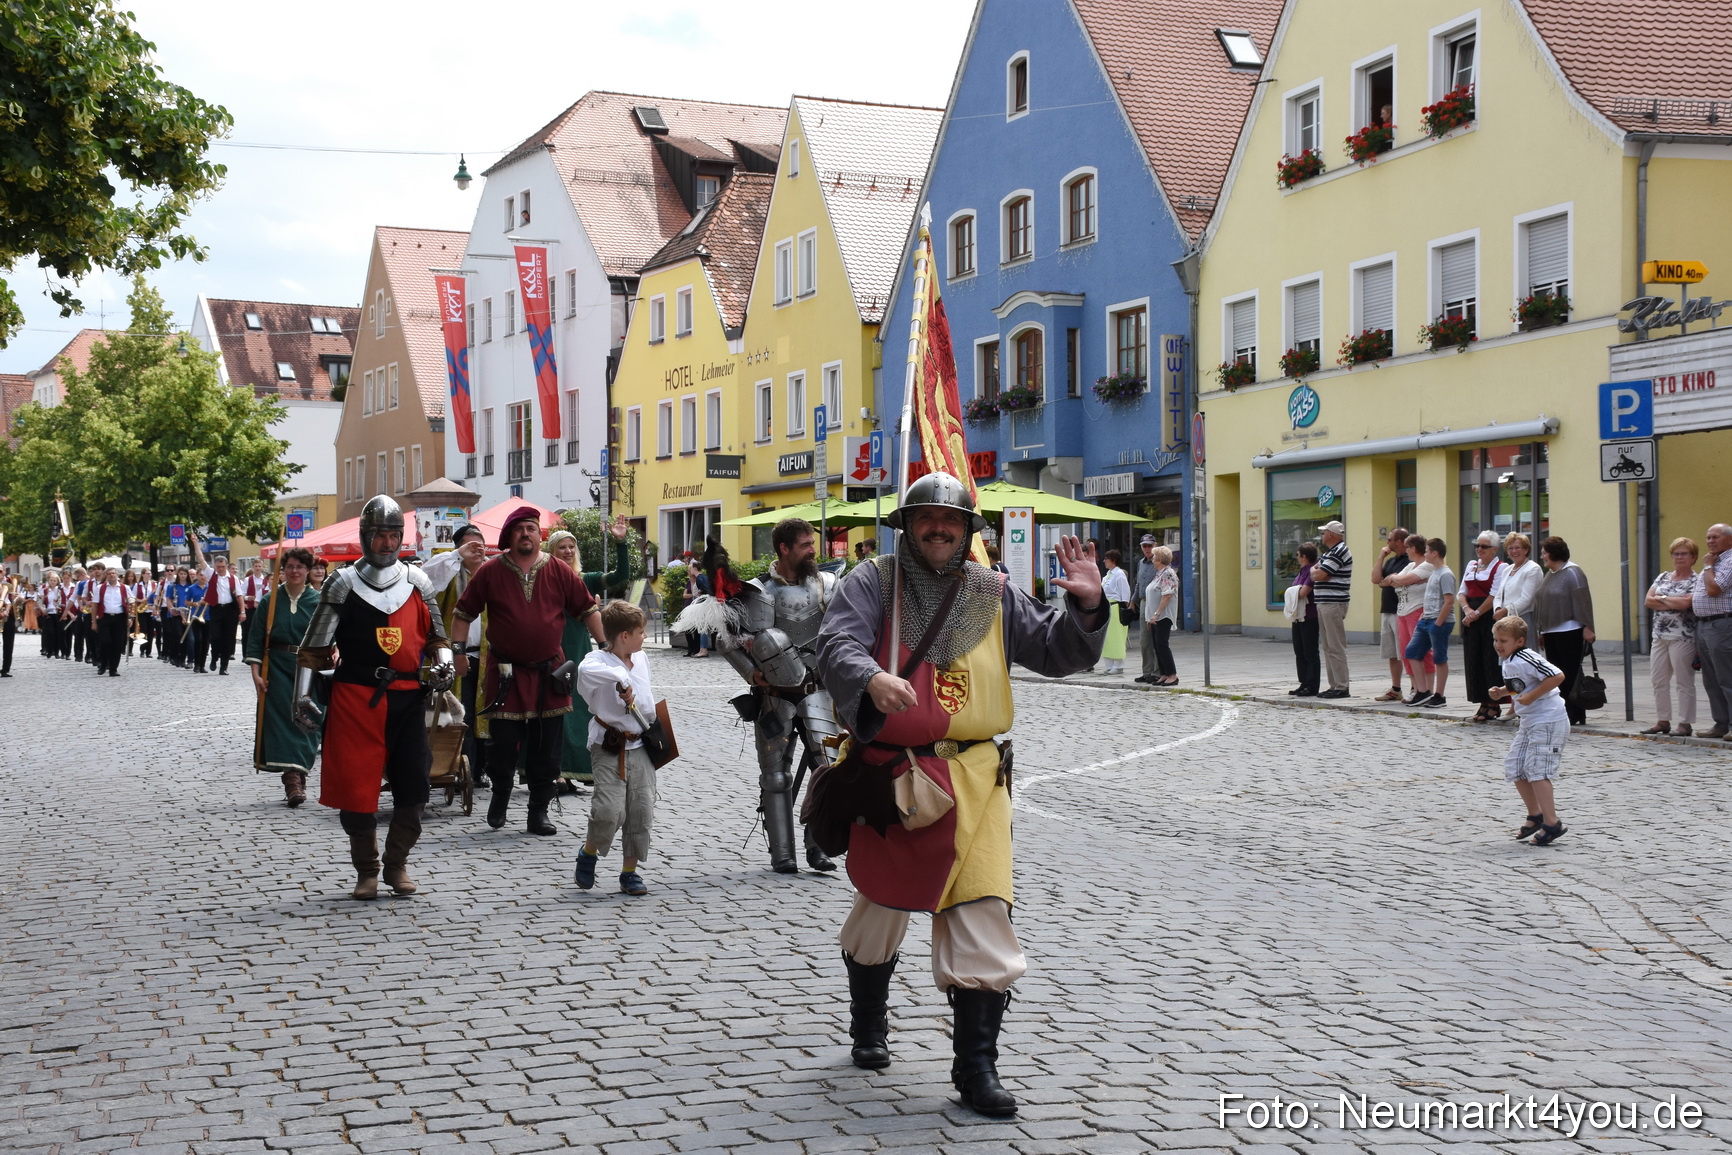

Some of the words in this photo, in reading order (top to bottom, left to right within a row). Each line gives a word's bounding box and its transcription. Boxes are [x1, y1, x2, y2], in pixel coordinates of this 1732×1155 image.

[520, 253, 537, 298] K&L
[535, 253, 543, 299] RUPPERT
[1656, 264, 1683, 279] KINO
[1685, 269, 1704, 279] 40m
[1618, 296, 1732, 333] Rialto
[665, 364, 694, 391] HOTEL
[701, 358, 736, 382] Lehmeier
[1682, 370, 1716, 393] KINO
[1167, 357, 1183, 441] WITTL
[1291, 391, 1315, 430] FASS
[1611, 388, 1641, 433] P
[776, 454, 807, 473] TAIFUN
[872, 435, 880, 464] P
[1617, 446, 1635, 455] nur
[708, 468, 739, 476] TAIFUN
[662, 481, 704, 500] Restaurant
